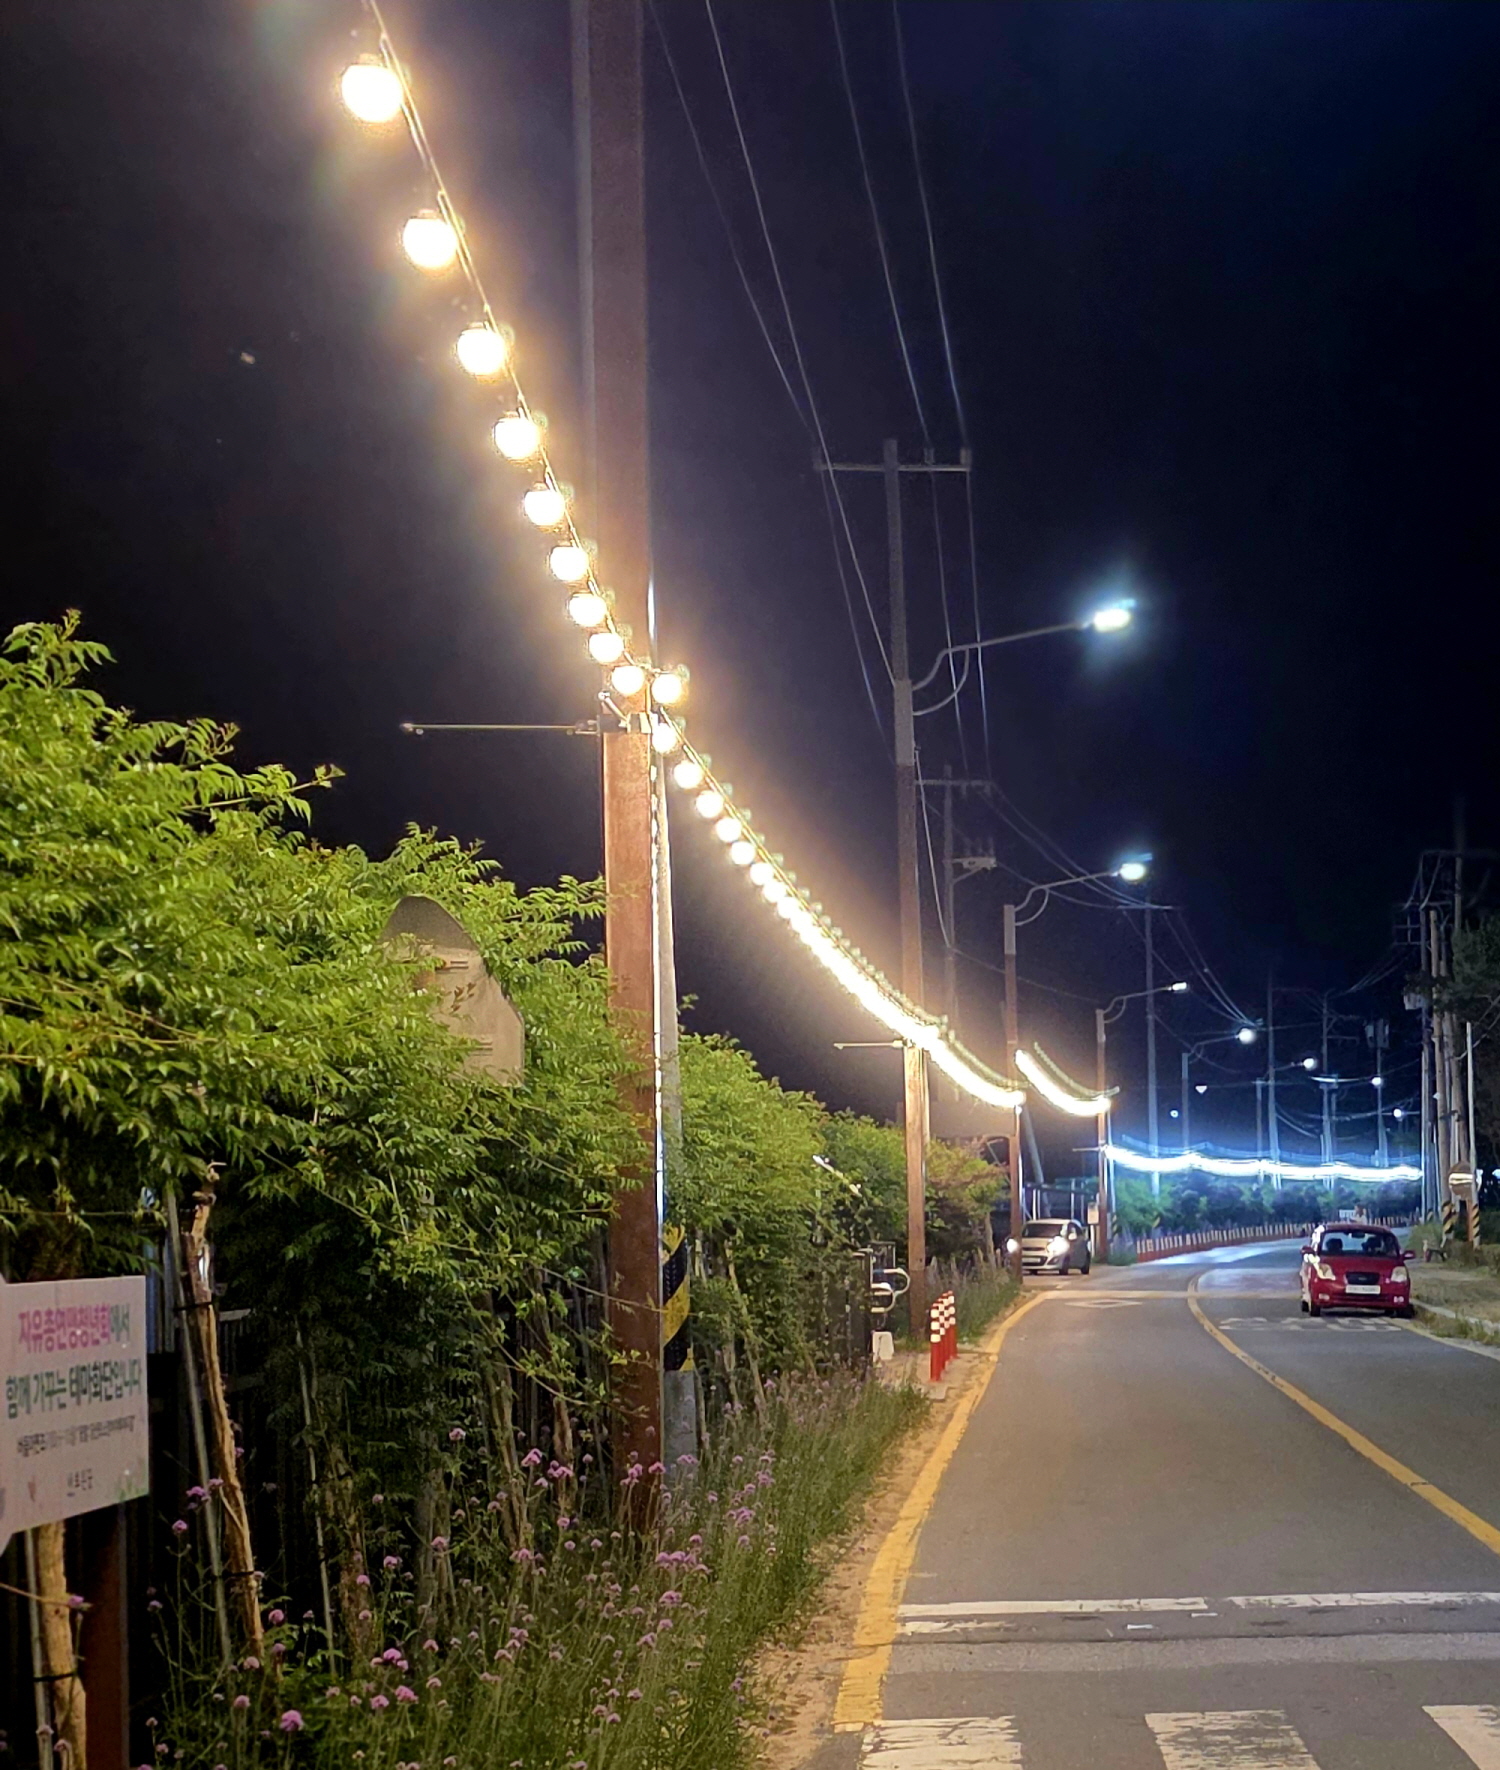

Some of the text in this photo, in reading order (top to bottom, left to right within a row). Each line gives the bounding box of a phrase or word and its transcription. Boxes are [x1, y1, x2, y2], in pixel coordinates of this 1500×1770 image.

[6, 1359, 141, 1419] 함께 가꾸는 테마화단입니다
